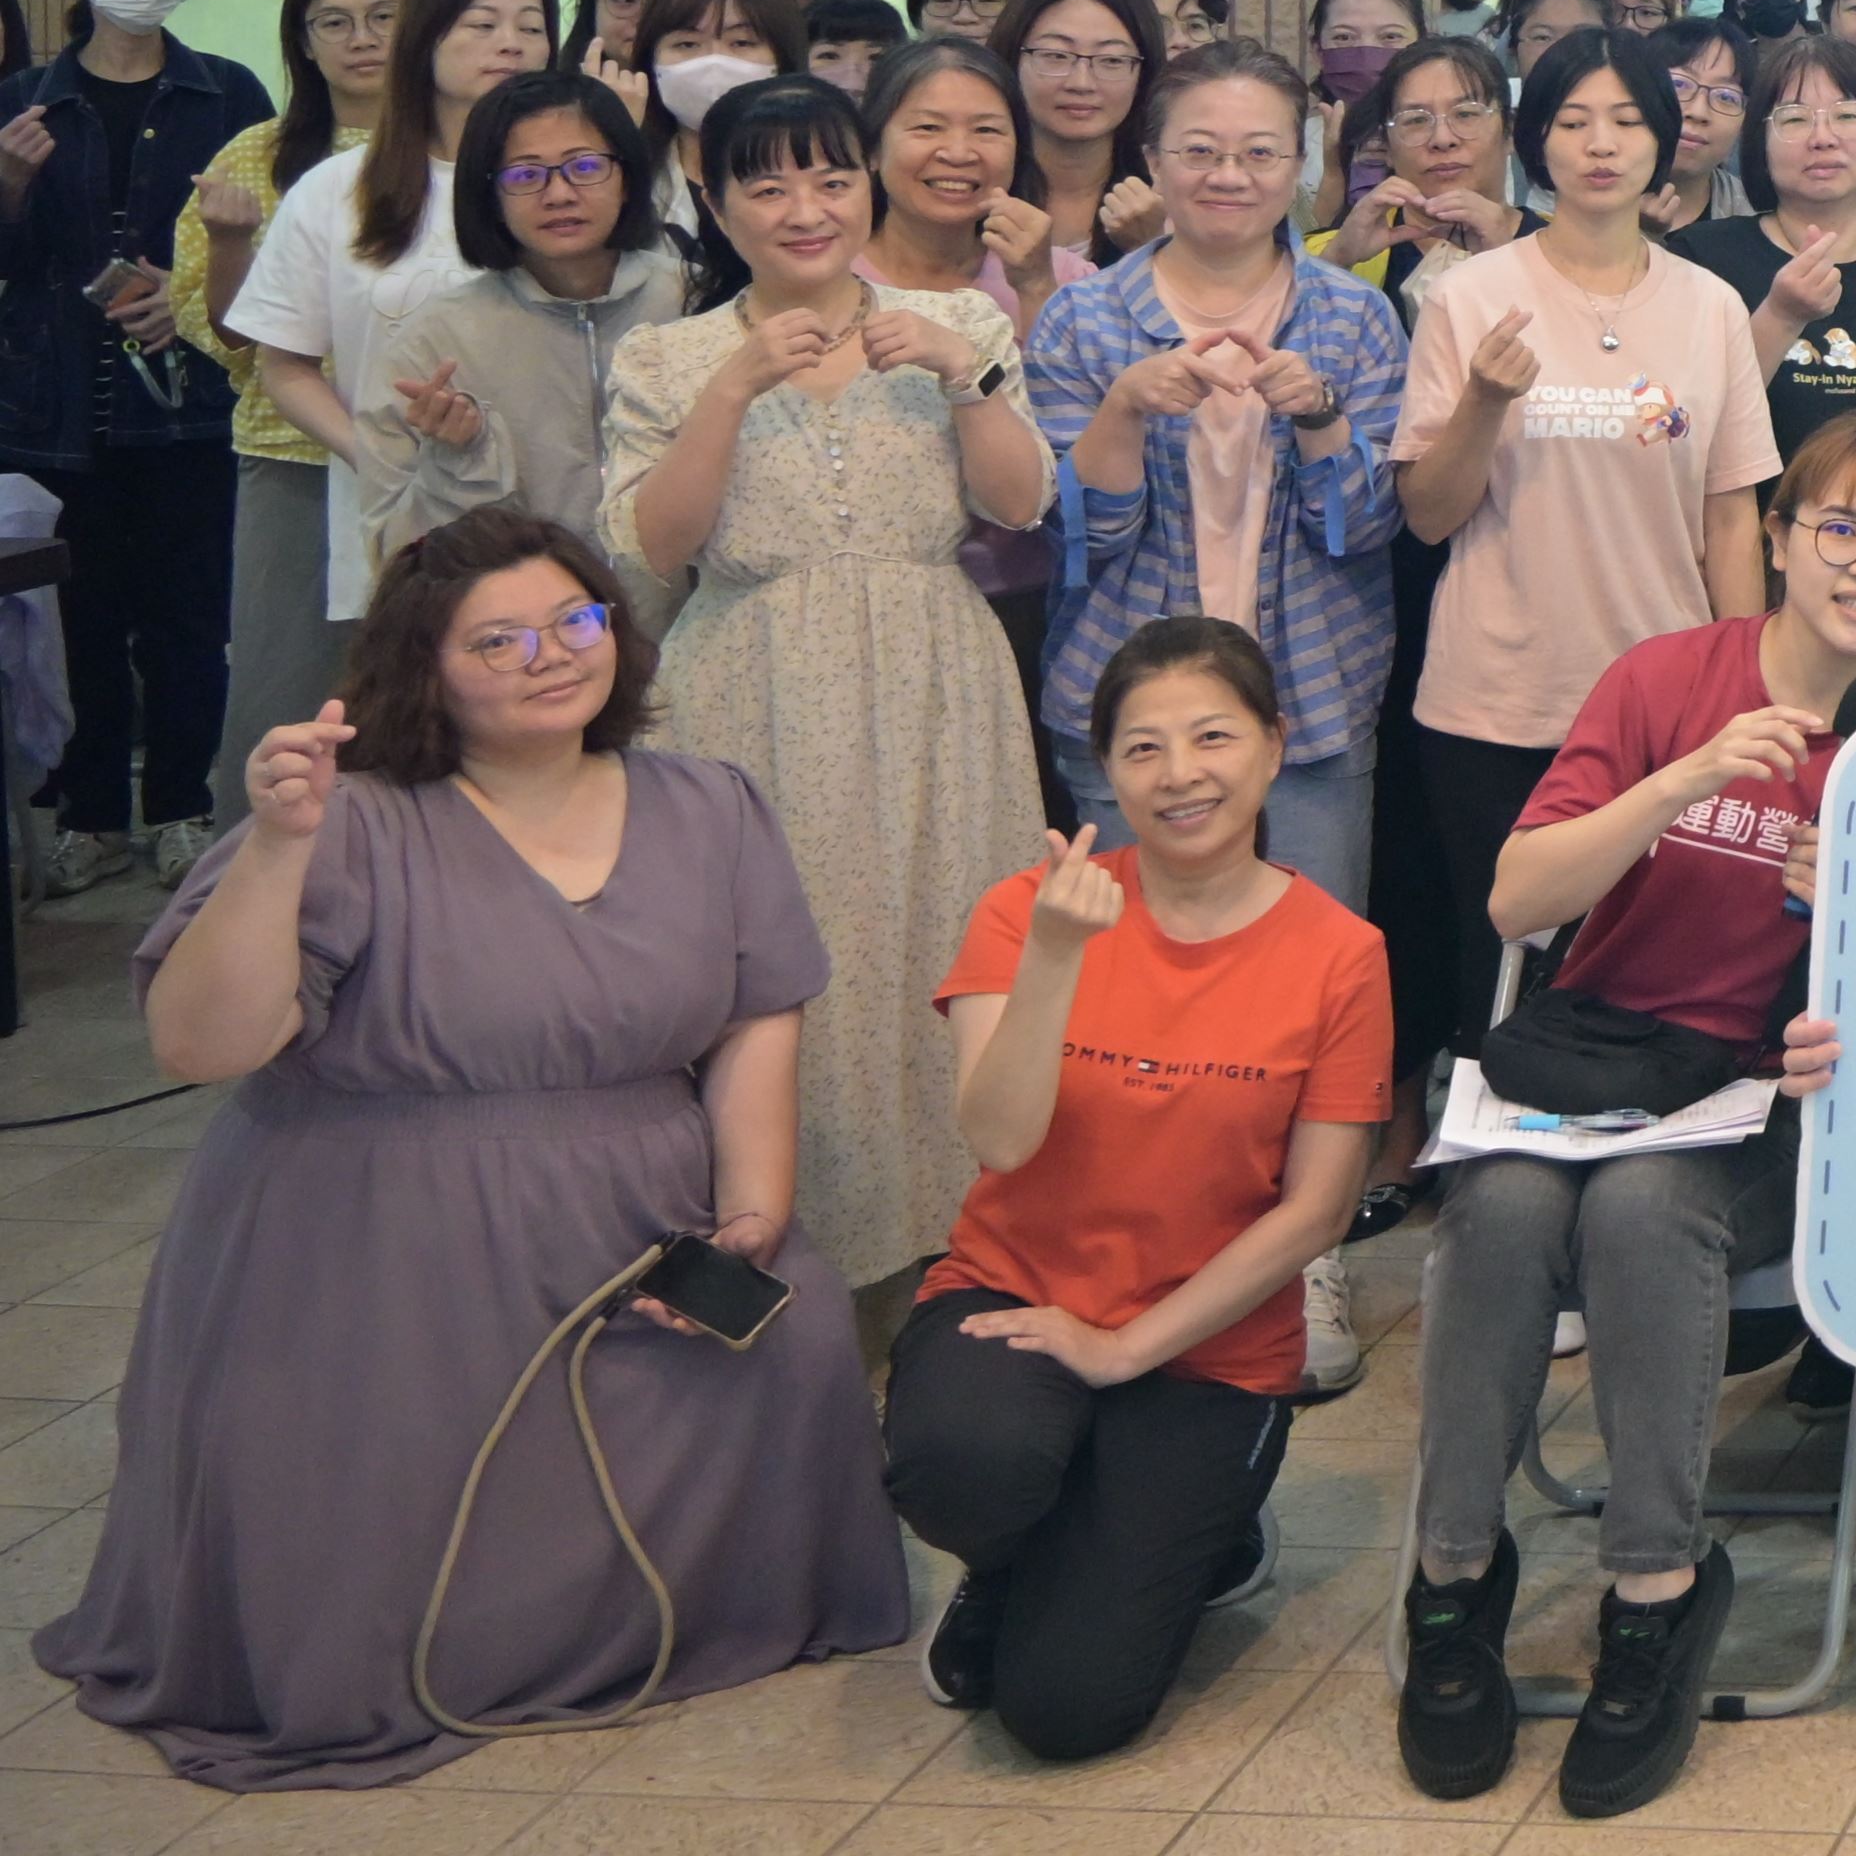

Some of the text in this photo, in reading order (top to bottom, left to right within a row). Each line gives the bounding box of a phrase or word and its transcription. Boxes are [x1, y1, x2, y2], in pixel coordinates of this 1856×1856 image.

[1527, 385, 1633, 404] YOU CAN
[1524, 403, 1584, 416] COUNT
[1585, 404, 1610, 416] ON
[1524, 416, 1625, 440] MARIO
[1671, 794, 1815, 854] 運動營
[1062, 1041, 1267, 1082] OMMY HILFIGER
